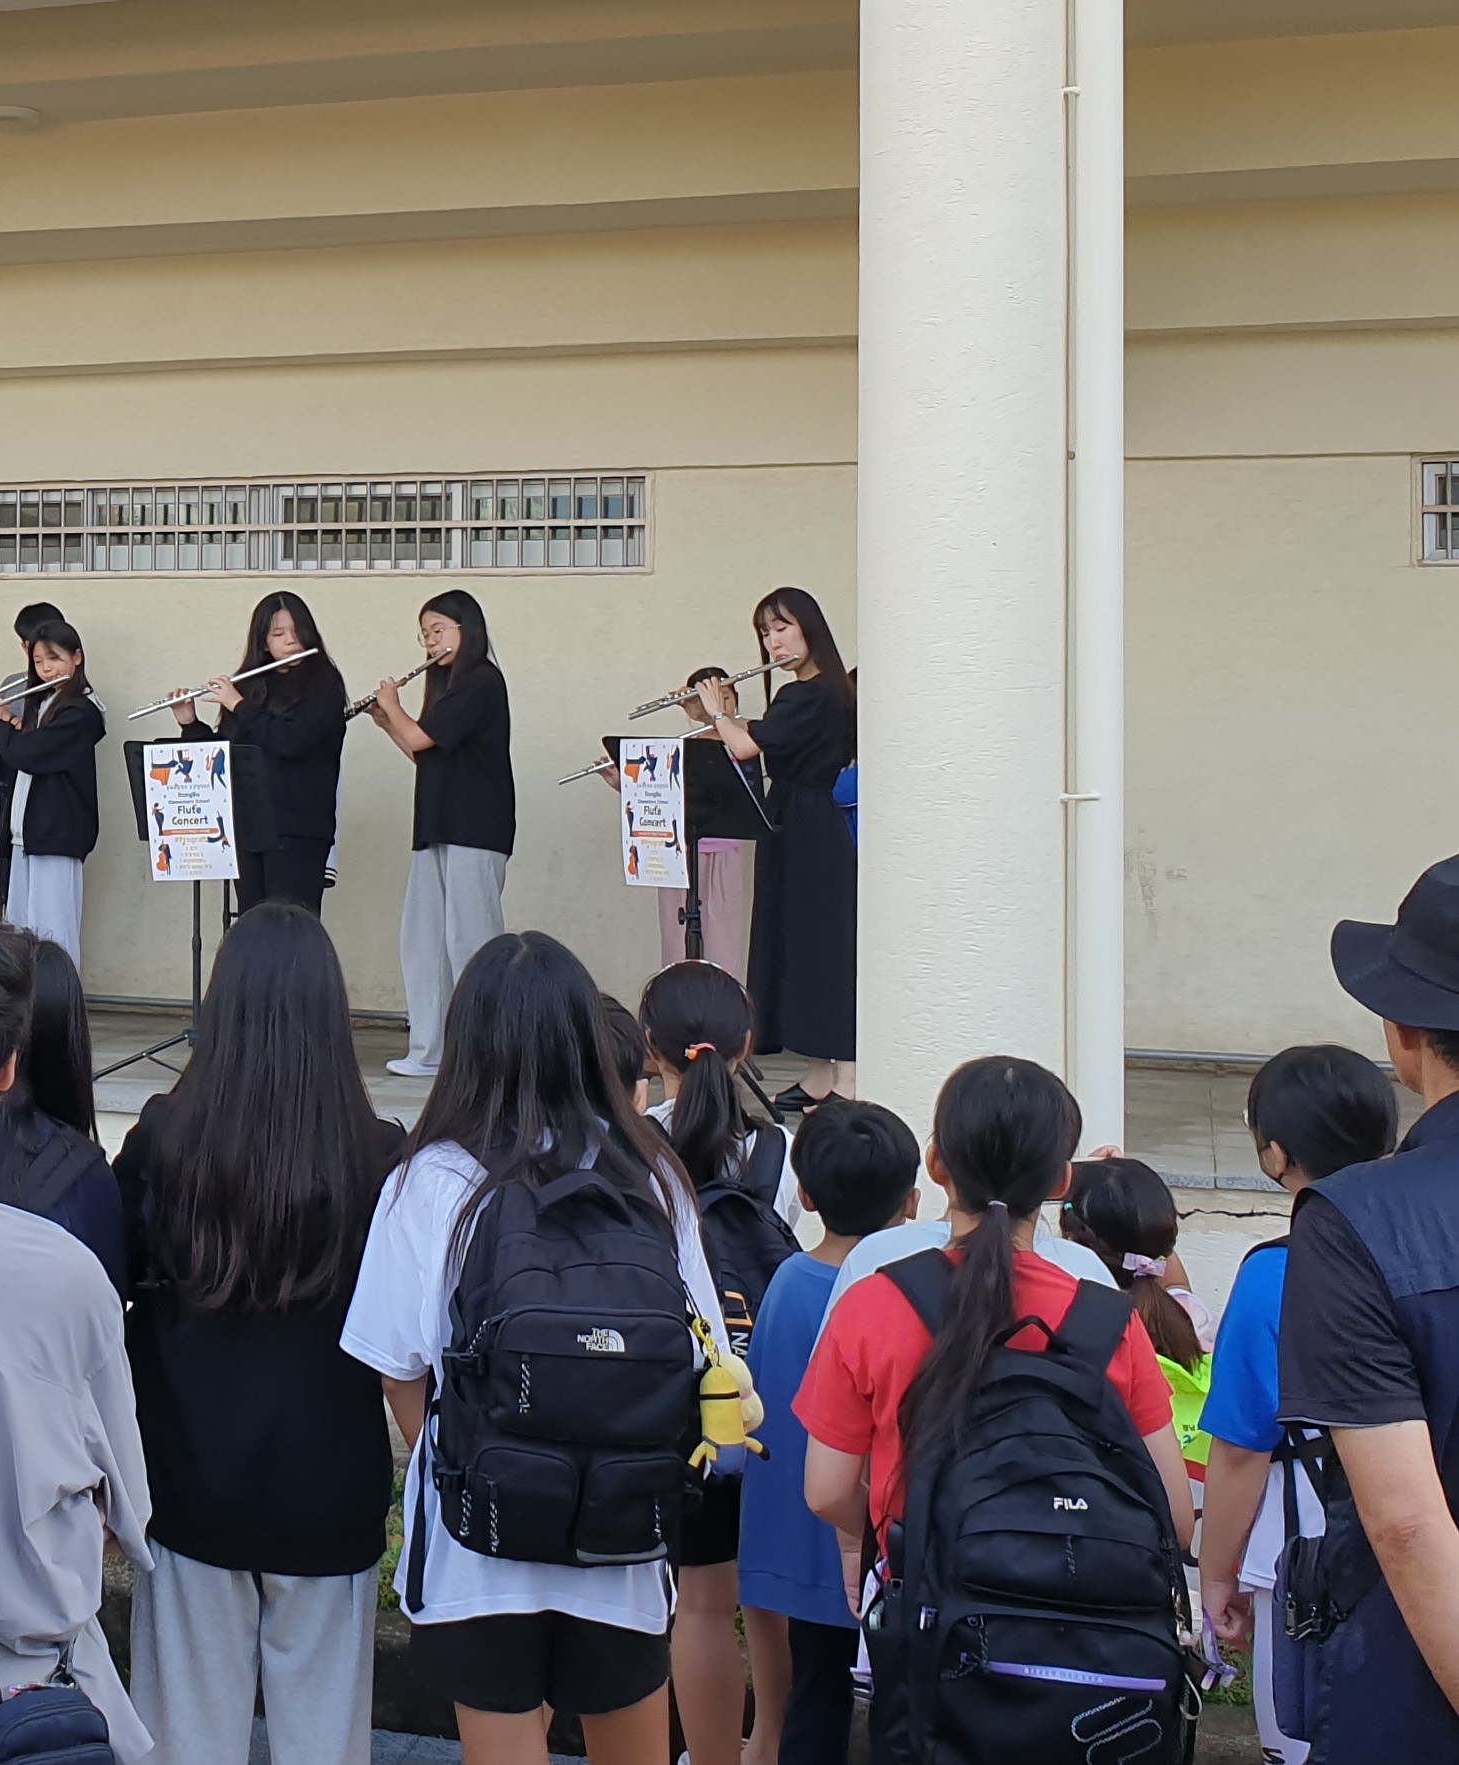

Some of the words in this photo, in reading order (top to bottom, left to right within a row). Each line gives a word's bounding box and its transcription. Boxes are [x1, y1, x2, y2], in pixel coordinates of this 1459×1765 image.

[177, 804, 202, 815] Flute
[643, 805, 662, 816] Flute
[171, 815, 209, 826] Concert
[639, 816, 667, 828] Concert
[1053, 1496, 1089, 1510] FILA
